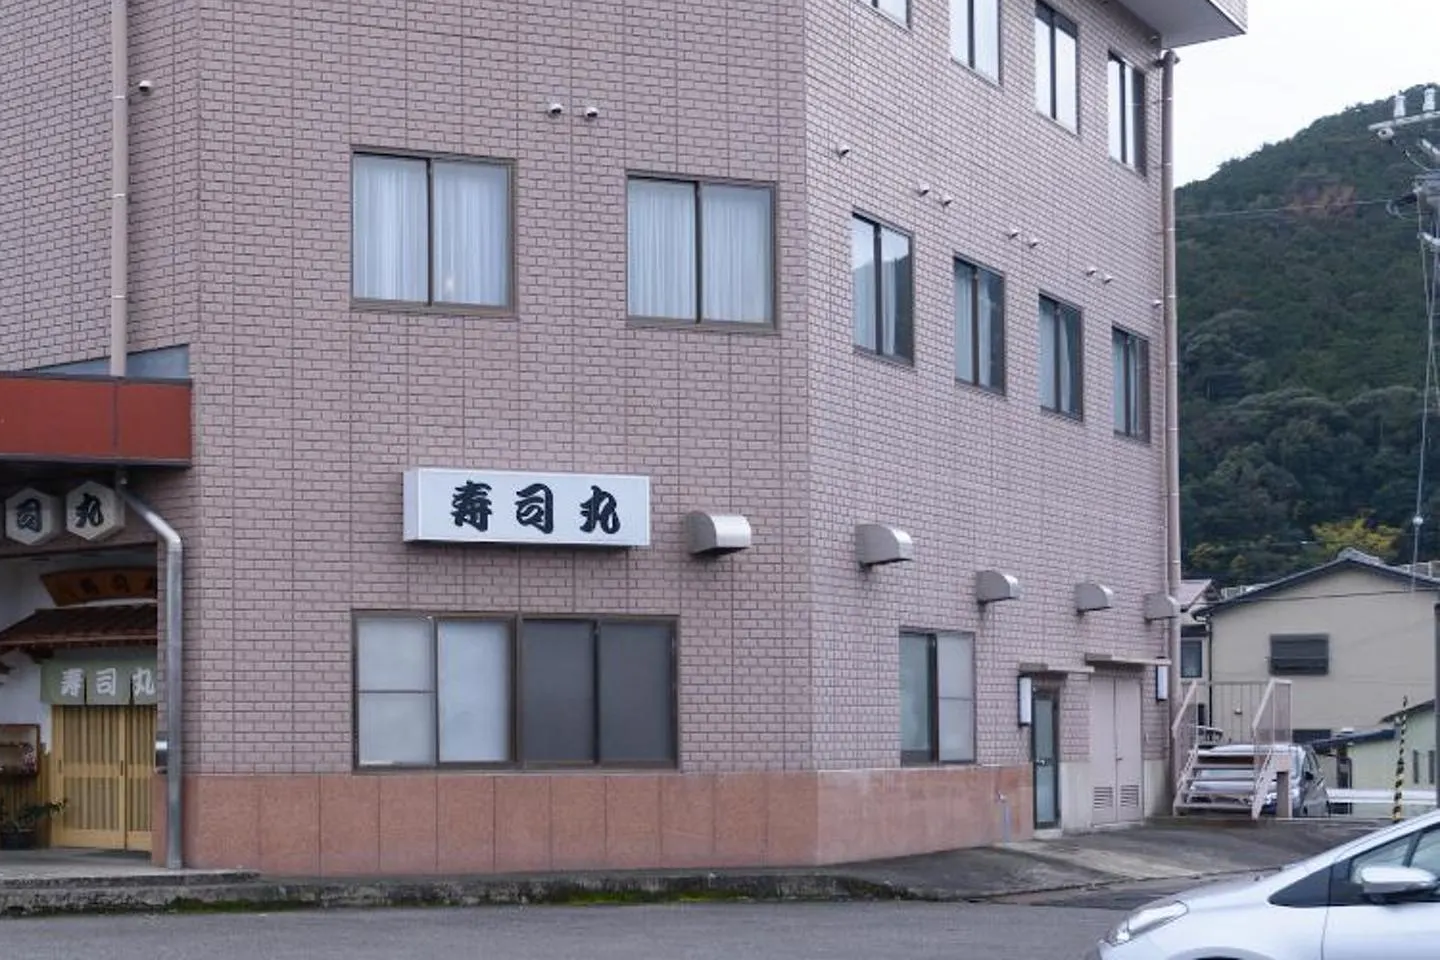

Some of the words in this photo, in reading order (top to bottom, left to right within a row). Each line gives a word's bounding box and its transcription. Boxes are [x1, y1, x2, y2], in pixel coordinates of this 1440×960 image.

[450, 480, 621, 535] 寿司丸
[60, 667, 157, 697] 寿司丸
